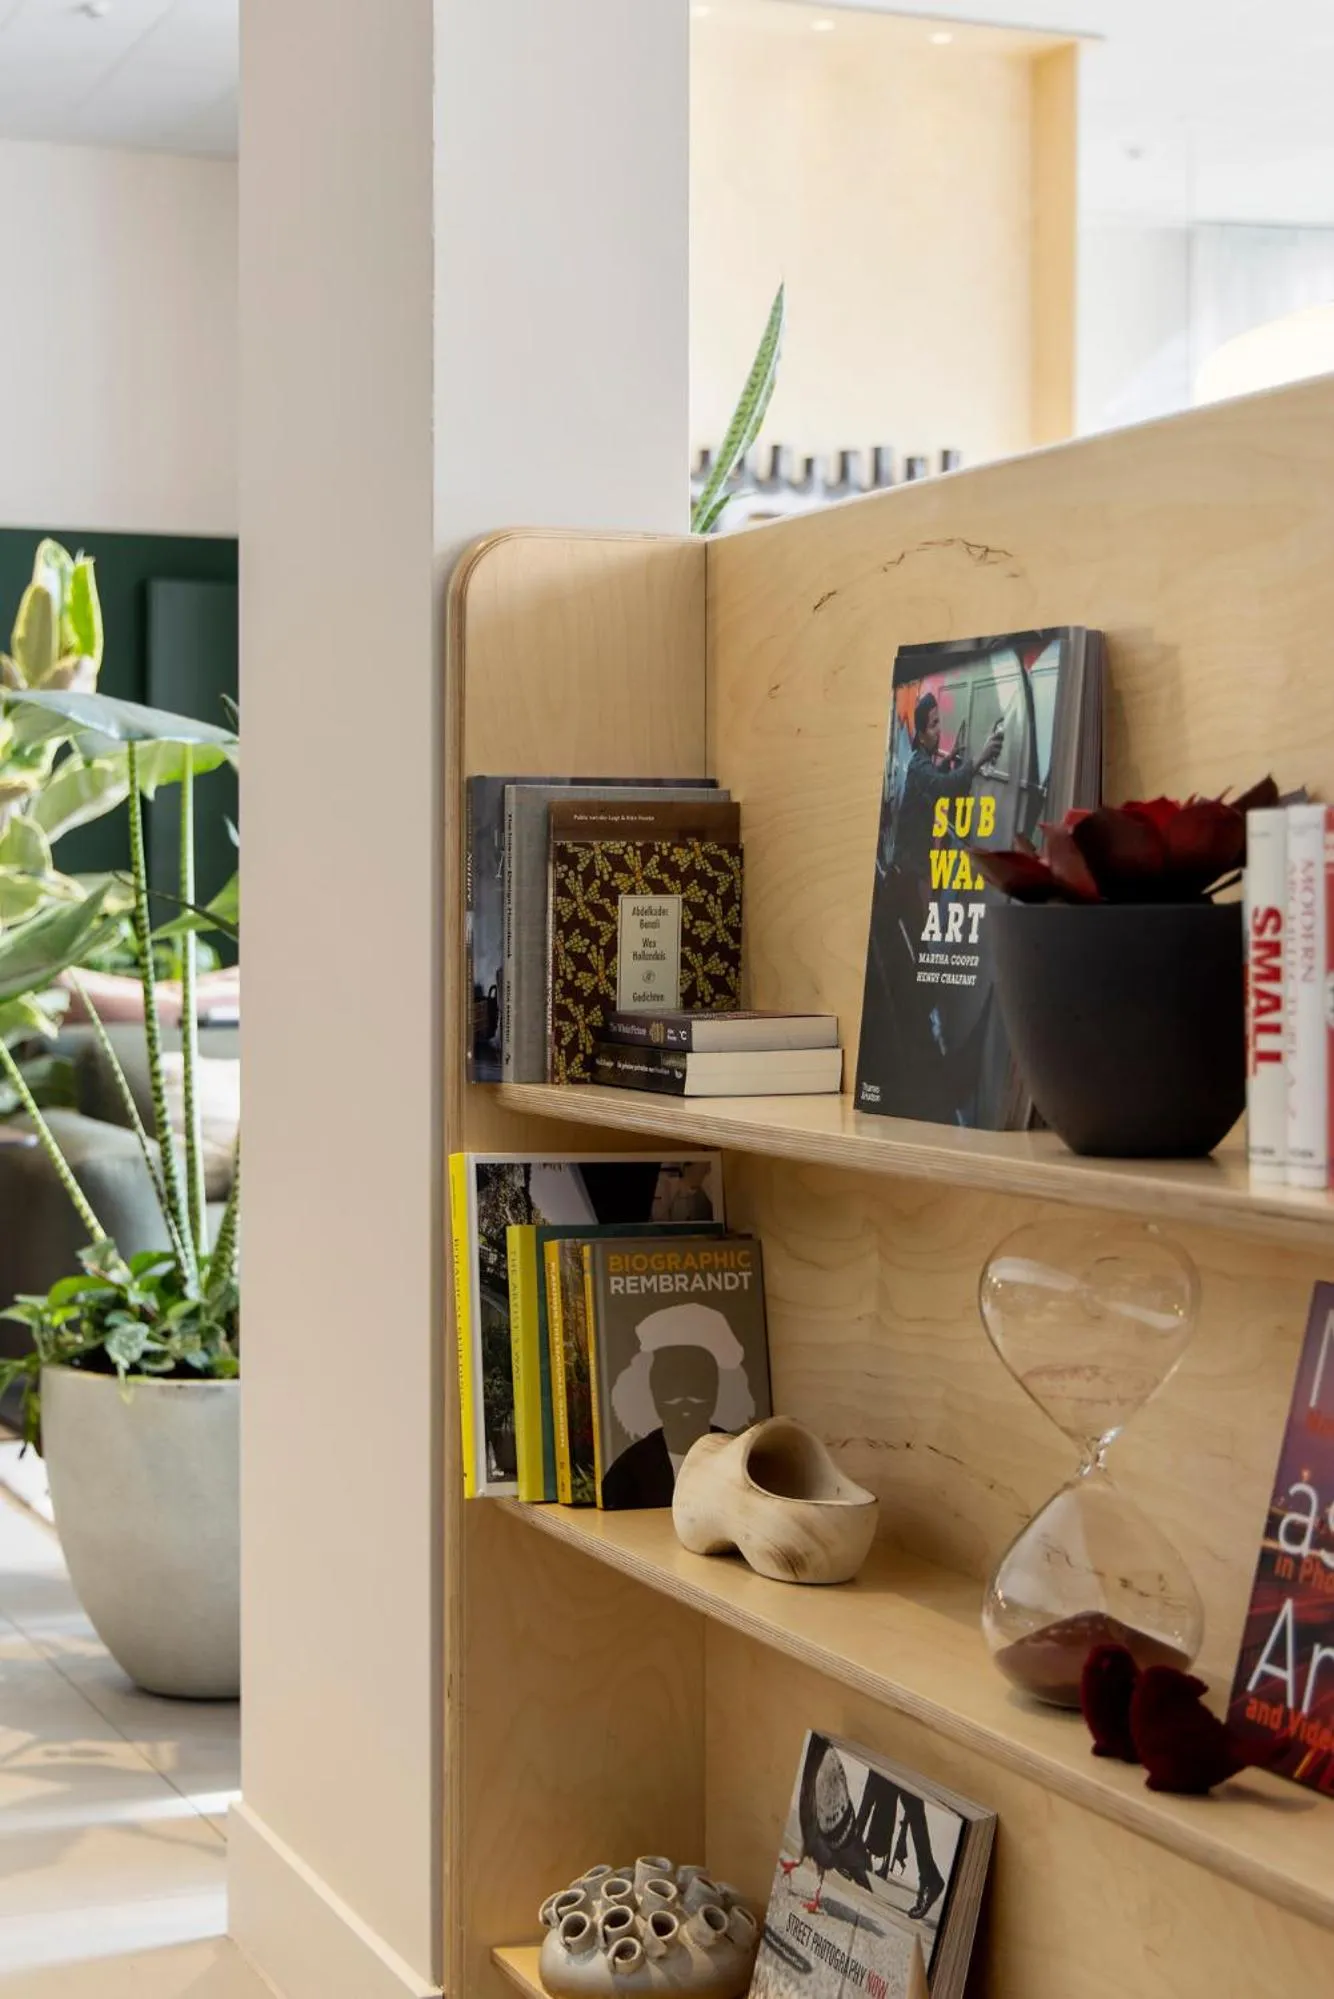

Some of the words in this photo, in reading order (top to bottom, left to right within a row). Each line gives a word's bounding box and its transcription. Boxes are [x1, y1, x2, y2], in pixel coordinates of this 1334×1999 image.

[932, 796, 996, 838] SUB
[929, 849, 985, 890] WA
[631, 905, 669, 917] Abdelkader
[921, 901, 986, 944] ART
[1300, 859, 1316, 984] MODERN
[918, 952, 949, 966] MARTHA
[951, 954, 980, 968] COOPER
[1252, 905, 1283, 1076] SMALL
[608, 1250, 752, 1273] BIOGRAPHIC
[609, 1271, 753, 1295] REMBRANDT
[1274, 1555, 1295, 1581] in
[1246, 1697, 1284, 1730] and
[785, 1911, 813, 1947] STREET
[810, 1931, 867, 1987] PHOTOGRAPHY
[865, 1967, 889, 1999] NOW
